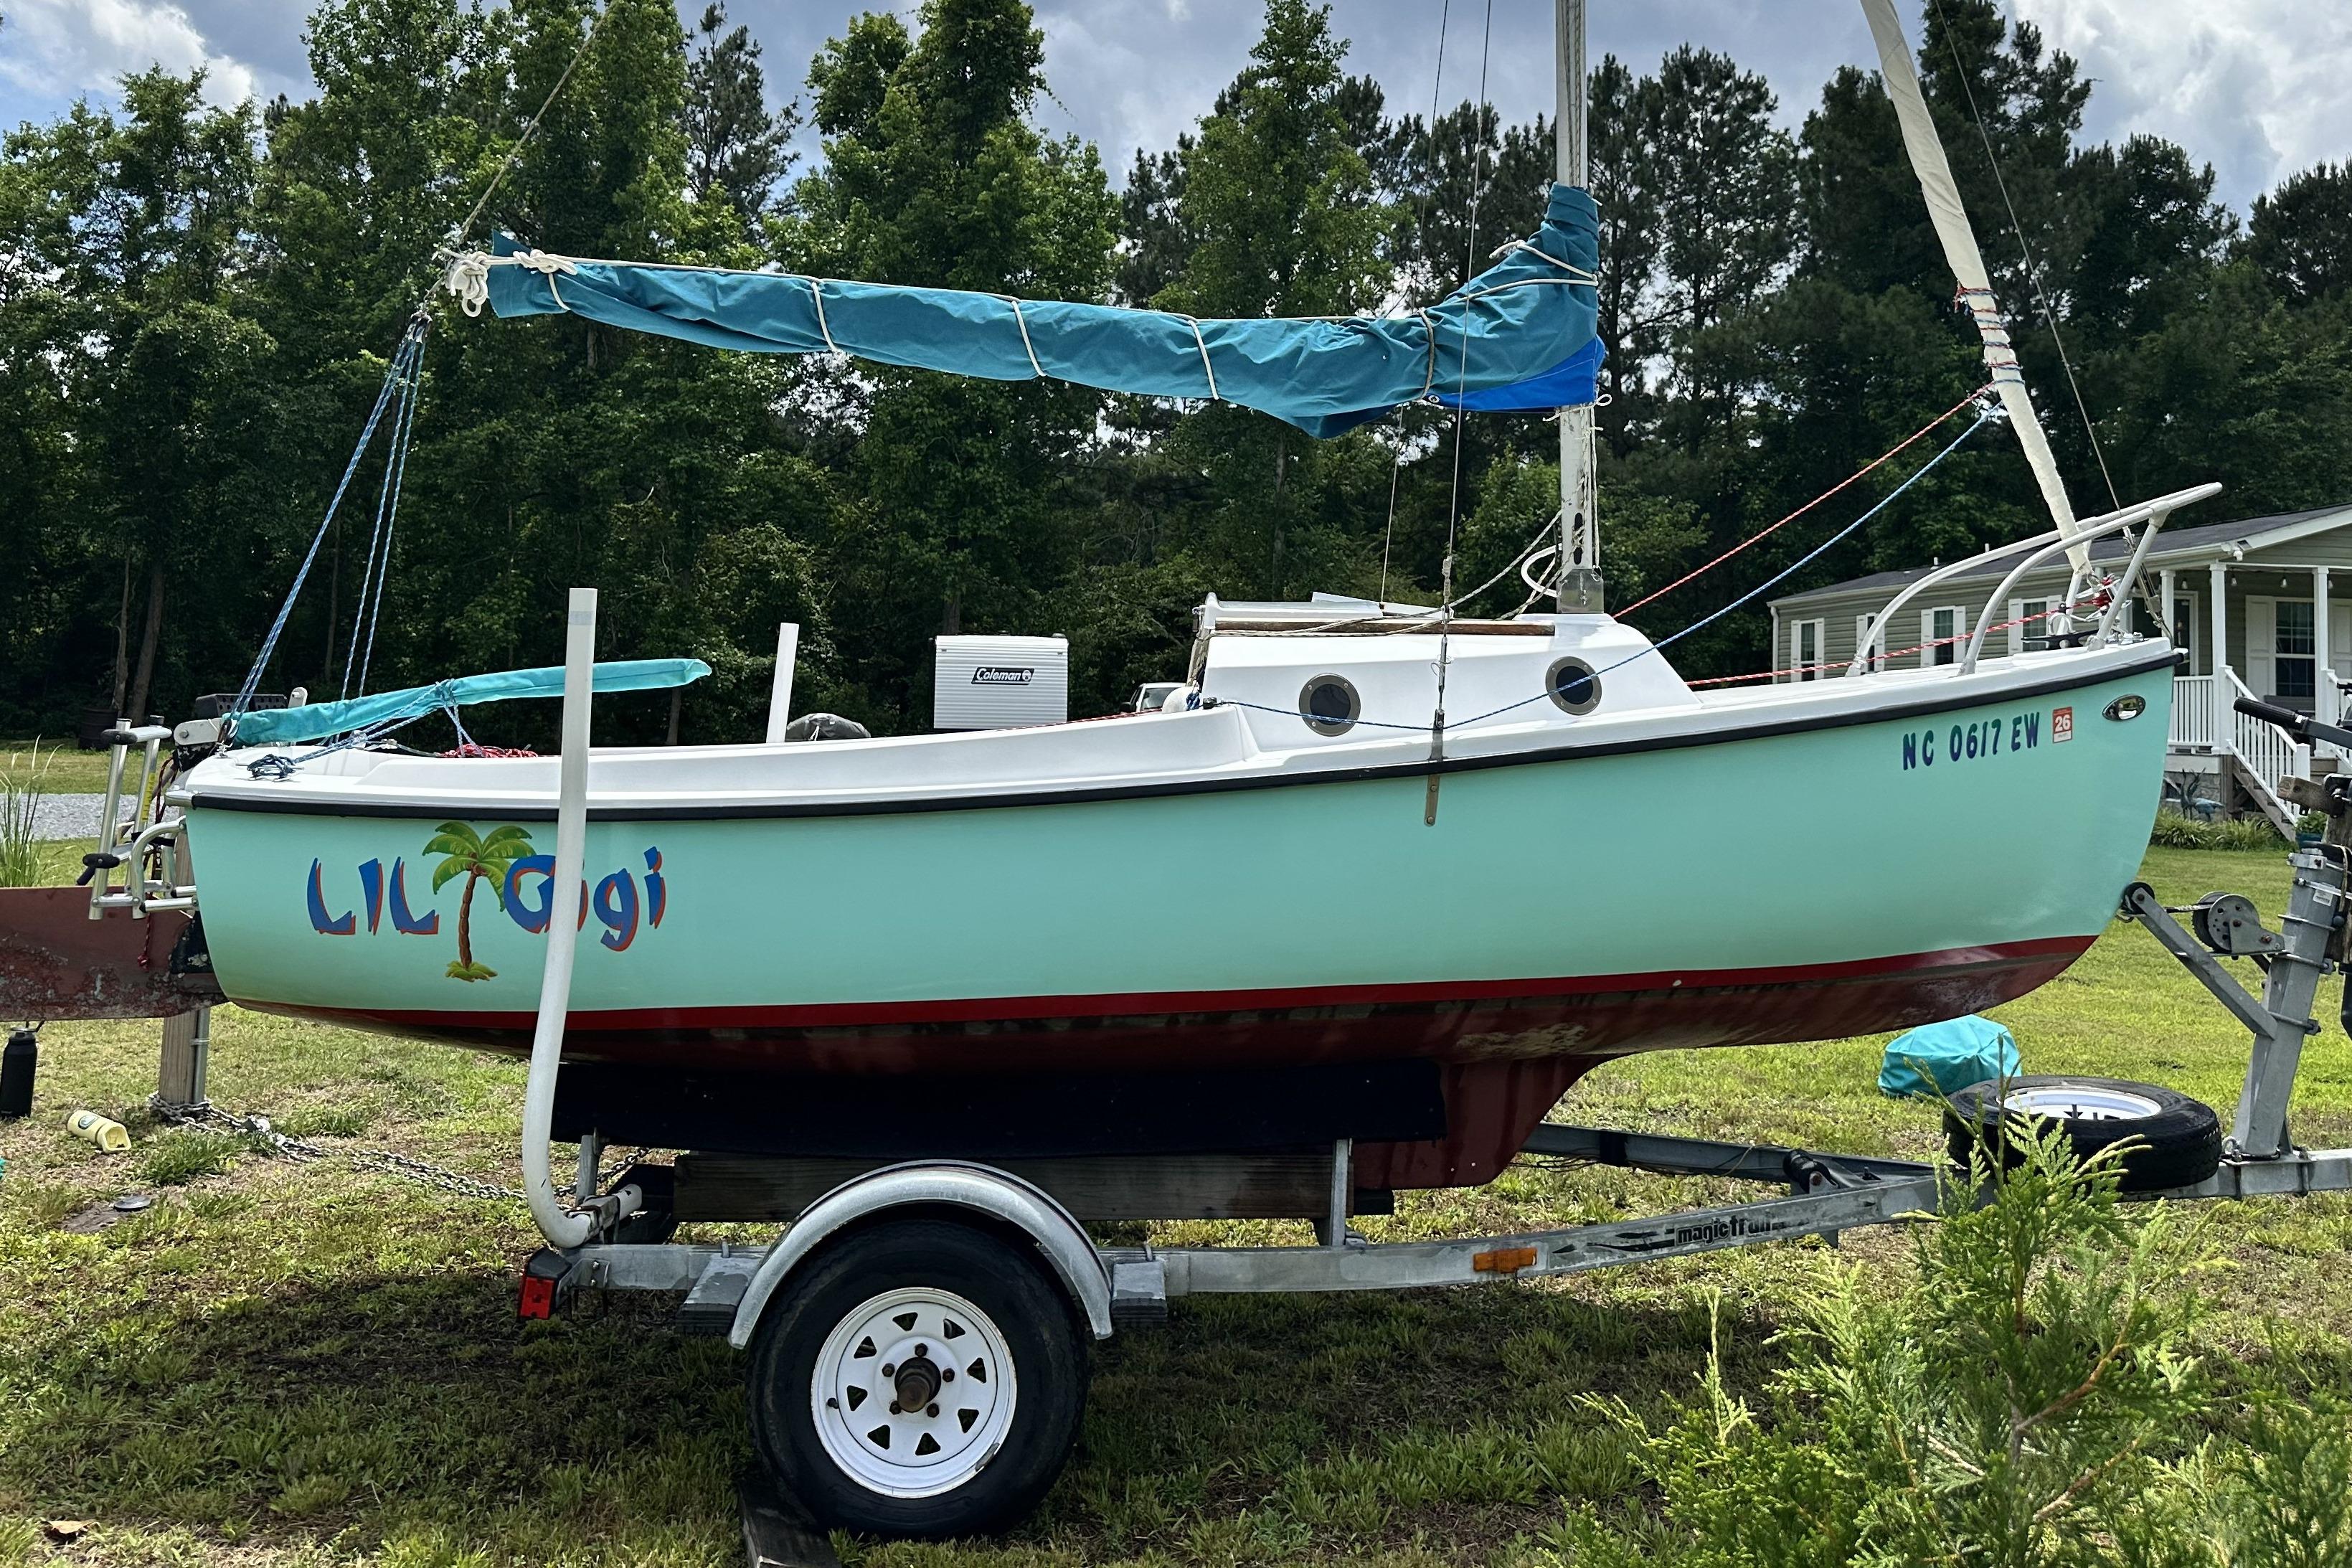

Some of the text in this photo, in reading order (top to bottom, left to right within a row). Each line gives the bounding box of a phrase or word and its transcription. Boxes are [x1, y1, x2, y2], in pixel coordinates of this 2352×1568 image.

[976, 668, 1021, 681] Coleman
[1903, 712, 2040, 770] NC 0617 EW
[2054, 714, 2071, 732] 26
[307, 846, 666, 951] LIL Ggi
